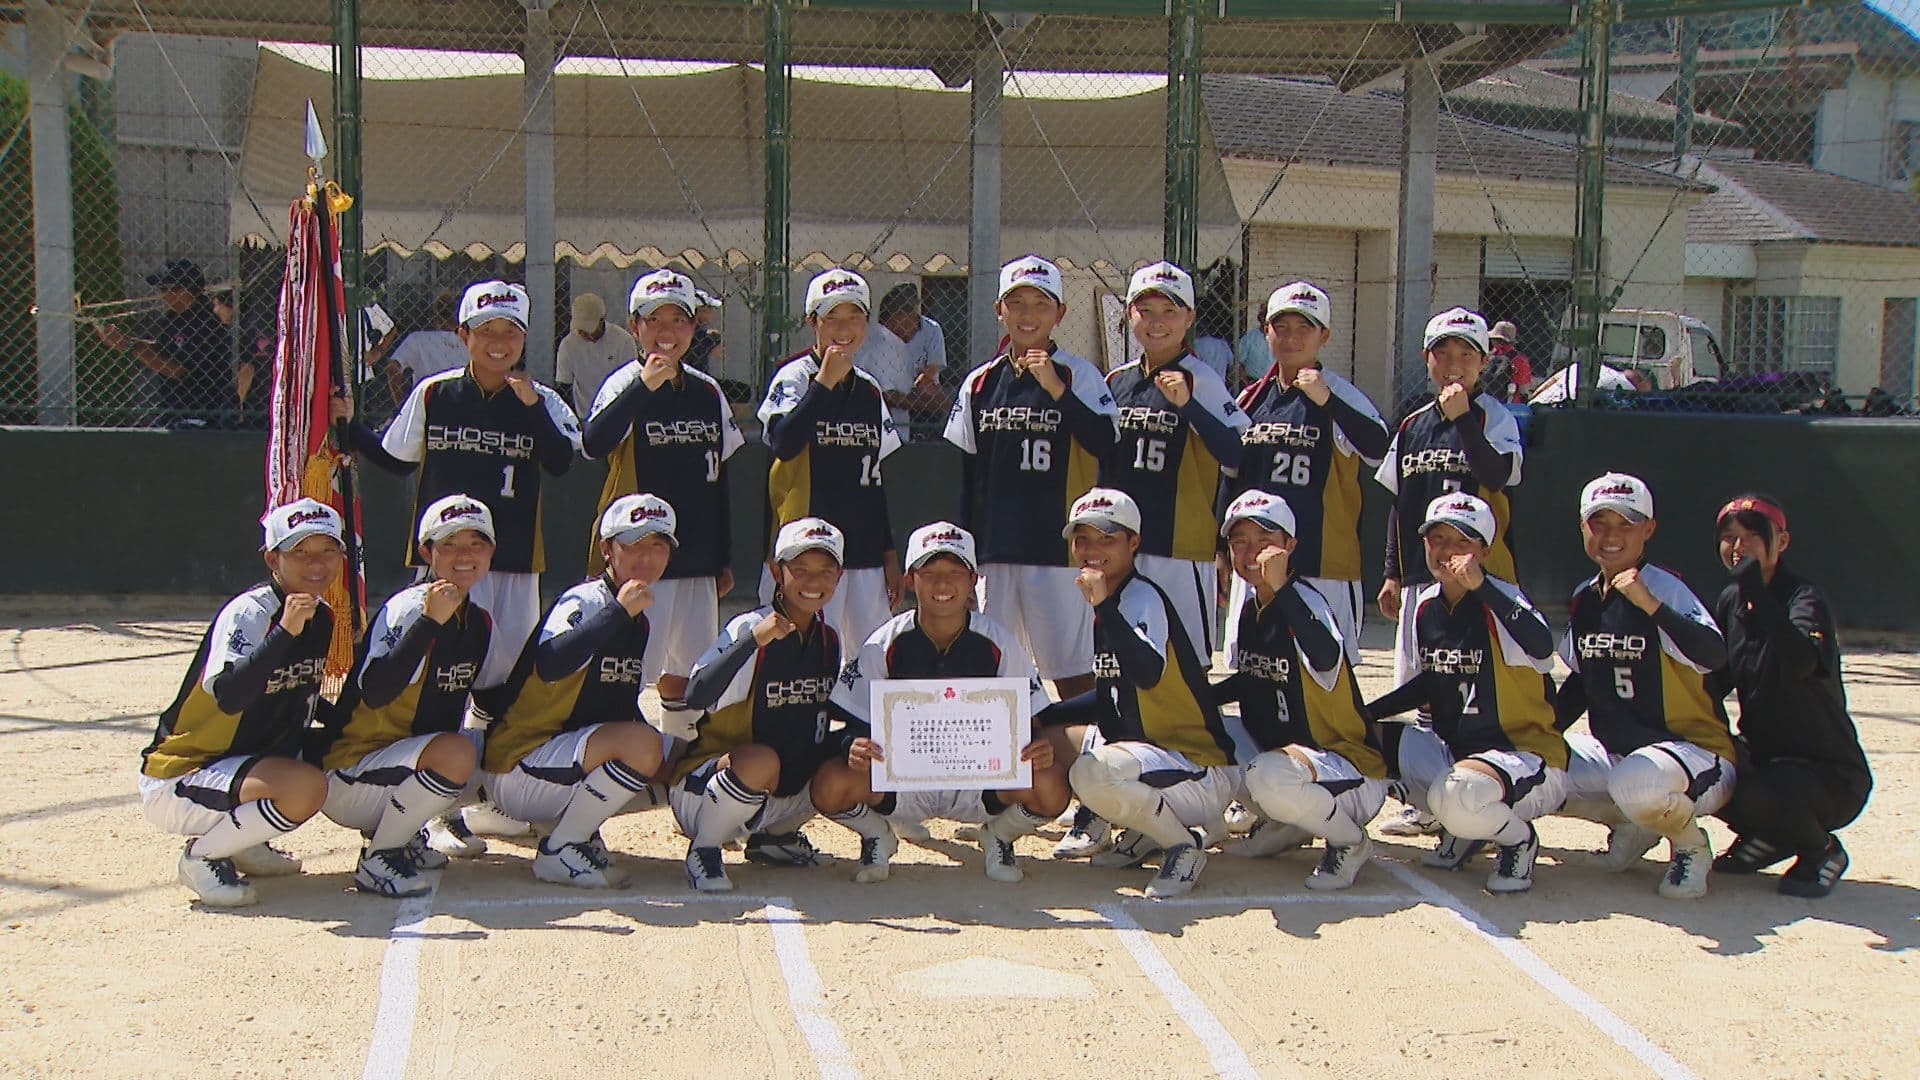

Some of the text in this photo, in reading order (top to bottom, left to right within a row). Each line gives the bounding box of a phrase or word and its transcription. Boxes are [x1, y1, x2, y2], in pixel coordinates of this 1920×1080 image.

[646, 420, 720, 438] CHOSH
[816, 420, 879, 440] CHOSH
[1119, 406, 1179, 427] OSHO
[1242, 422, 1321, 442] HOSHO
[428, 425, 534, 451] CHOSHO
[1133, 436, 1166, 472] 15
[1019, 438, 1051, 472] 16
[1271, 451, 1311, 487] 26
[1402, 448, 1468, 469] CHOSH
[500, 464, 515, 498] 1
[1613, 665, 1635, 699] 5
[1276, 689, 1289, 722] 9
[814, 711, 828, 744] 8
